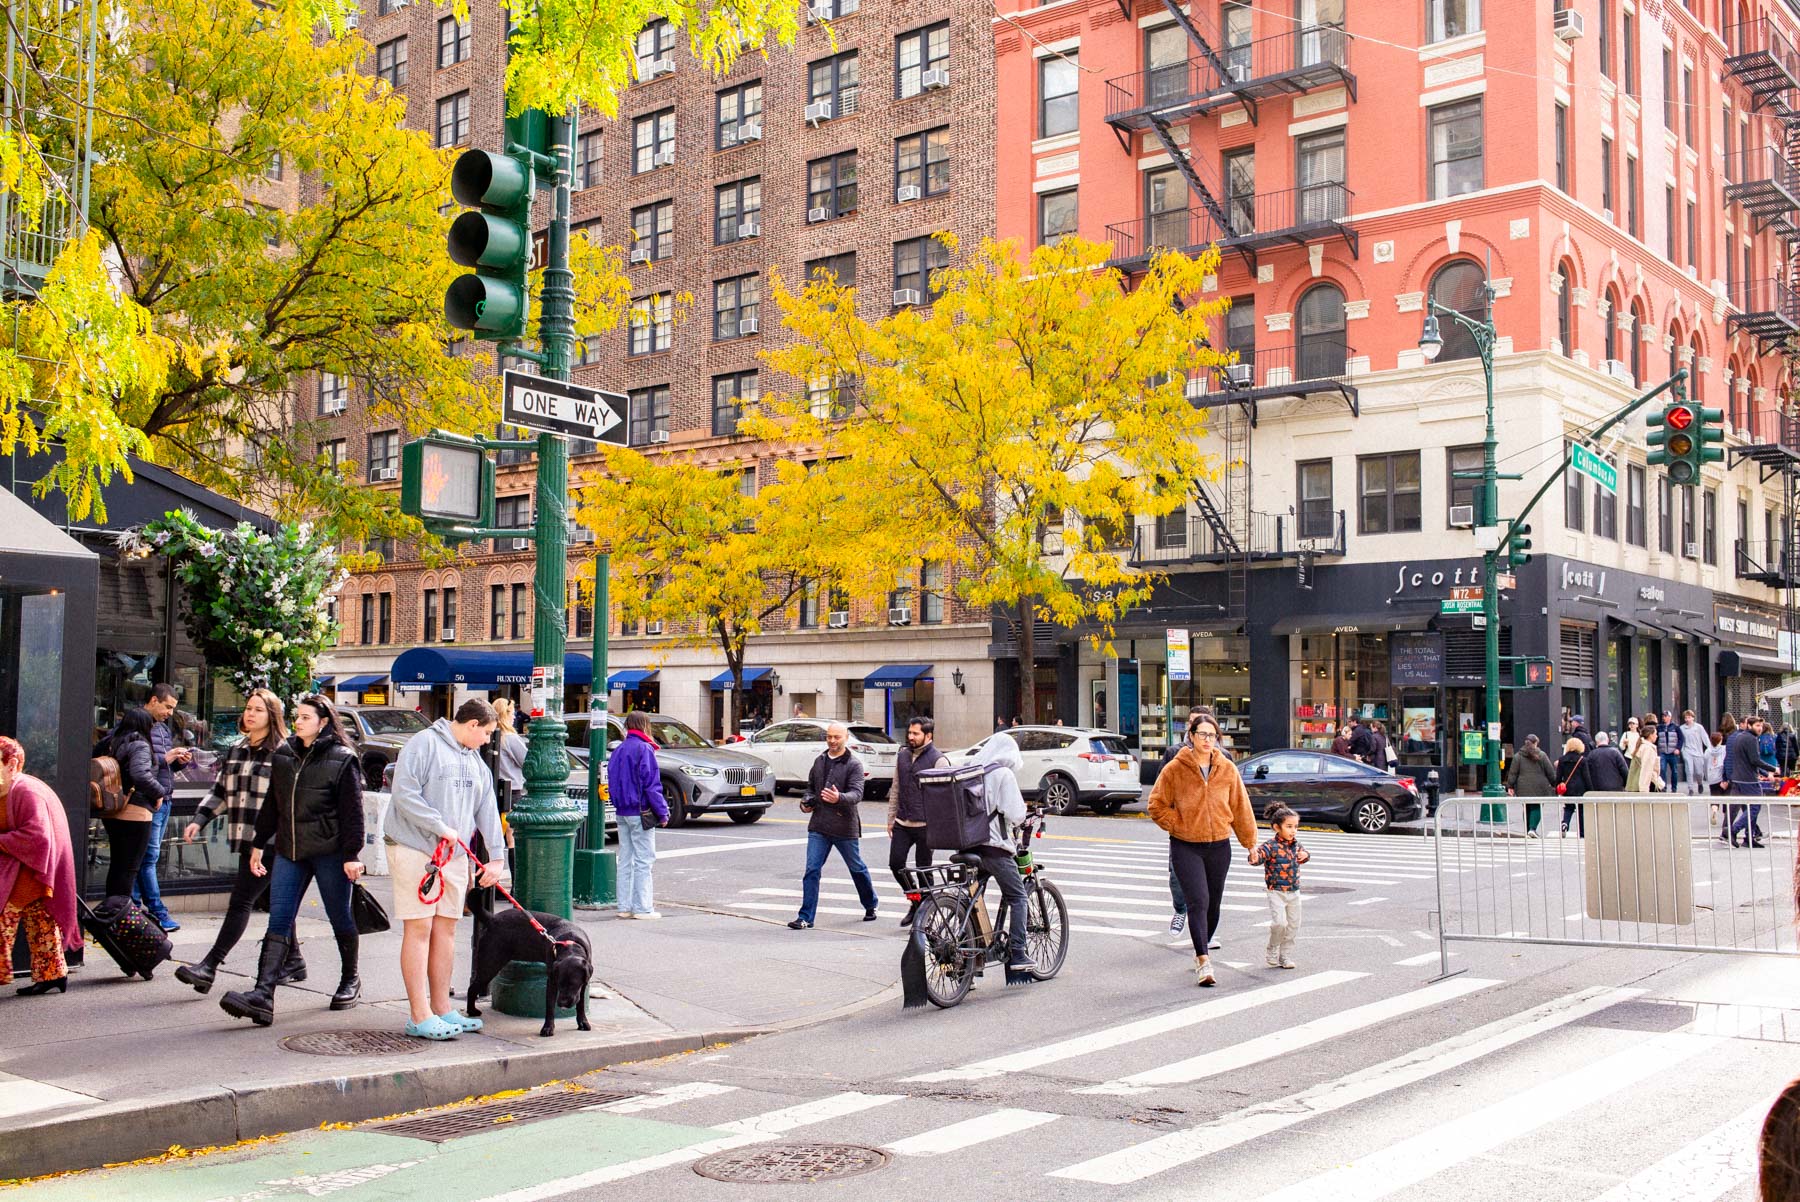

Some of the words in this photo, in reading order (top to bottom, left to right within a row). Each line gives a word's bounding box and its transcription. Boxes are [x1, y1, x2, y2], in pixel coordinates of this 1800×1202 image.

[523, 391, 558, 417] ONE
[575, 402, 610, 426] WAY
[1577, 450, 1607, 482] Columbus
[1395, 565, 1479, 594] Scott
[1561, 562, 1594, 590] Scott
[1597, 571, 1606, 596] J
[1640, 585, 1665, 602] salon
[417, 672, 425, 680] 50
[497, 675, 527, 683] RUXTON
[1546, 665, 1552, 682] 3
